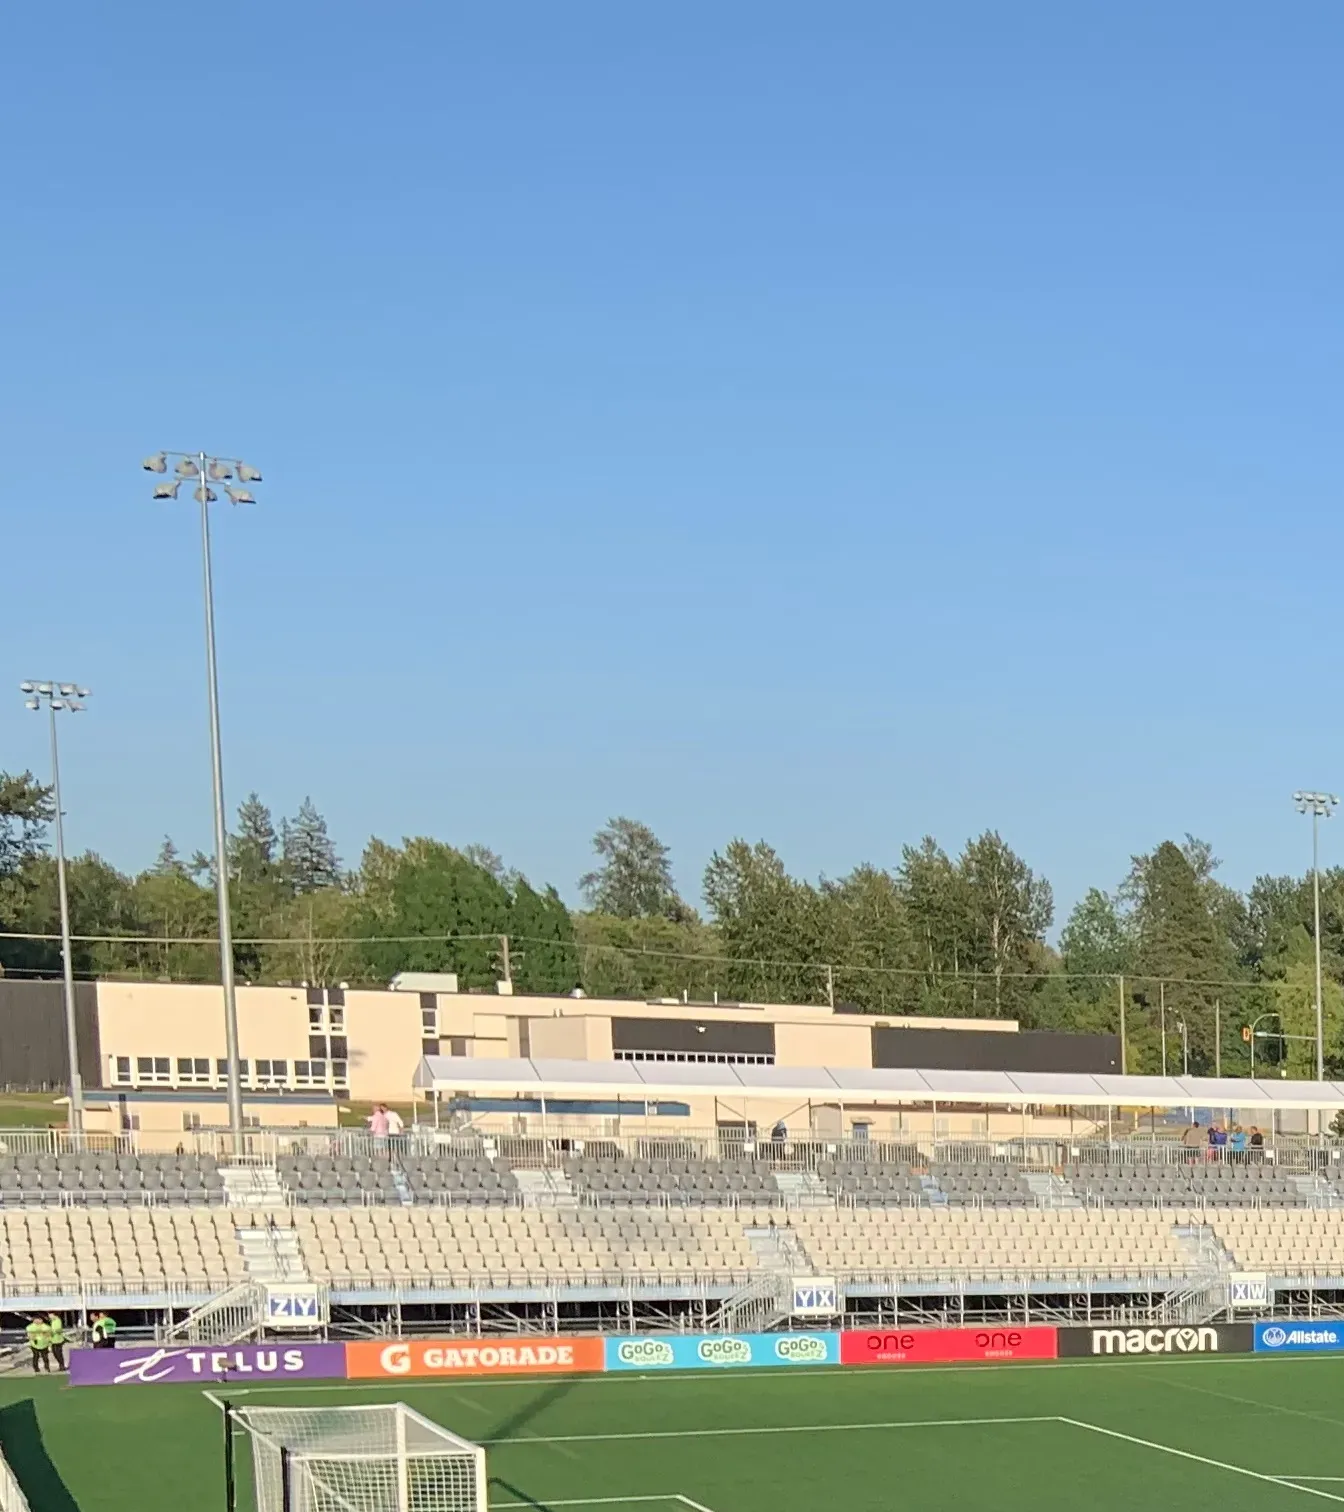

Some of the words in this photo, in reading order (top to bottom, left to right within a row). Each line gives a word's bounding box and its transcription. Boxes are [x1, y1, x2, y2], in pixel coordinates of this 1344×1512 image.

[797, 1291, 812, 1307] Y
[818, 1290, 833, 1306] X
[1235, 1284, 1248, 1299] X
[1250, 1284, 1265, 1299] W
[274, 1301, 288, 1317] Z
[299, 1301, 315, 1316] Y
[867, 1335, 914, 1350] one
[975, 1332, 1022, 1348] one
[1092, 1327, 1218, 1354] macron
[1286, 1330, 1338, 1345] Allstate
[186, 1350, 304, 1373] TELUS
[423, 1346, 573, 1369] GATORADE
